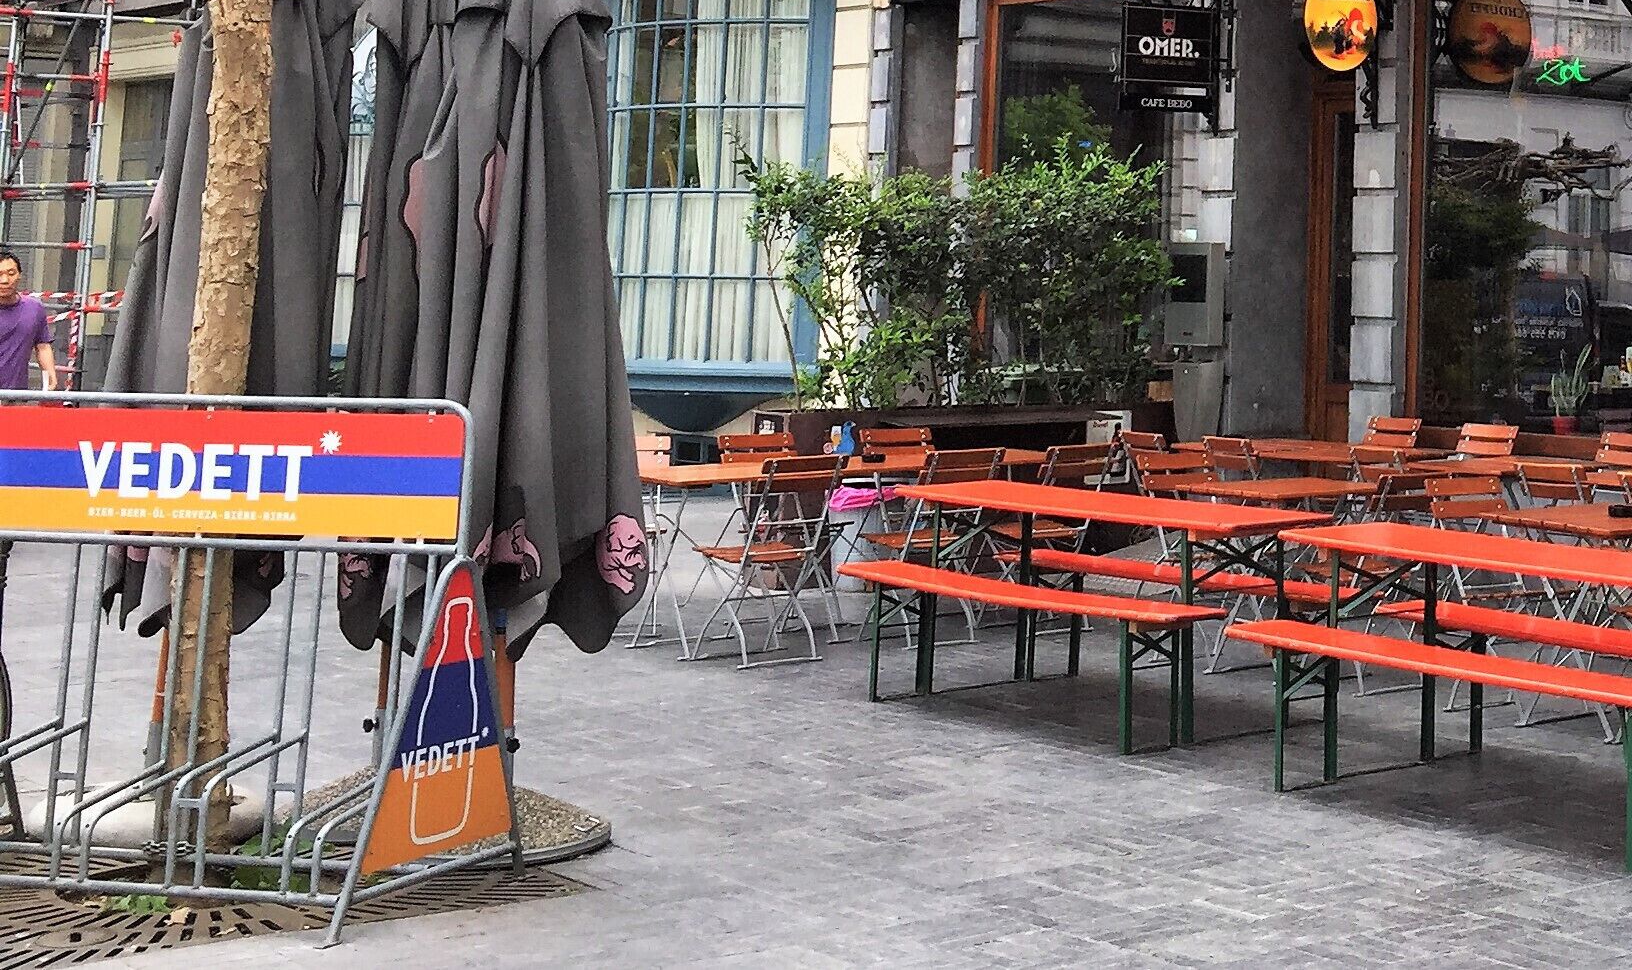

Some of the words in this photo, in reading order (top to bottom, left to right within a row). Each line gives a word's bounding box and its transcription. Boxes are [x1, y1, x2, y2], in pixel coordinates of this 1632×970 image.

[1138, 36, 1200, 58] OMER.
[1536, 57, 1591, 86] Zot
[78, 441, 313, 502] VEDETT
[401, 735, 480, 783] VEDETT
